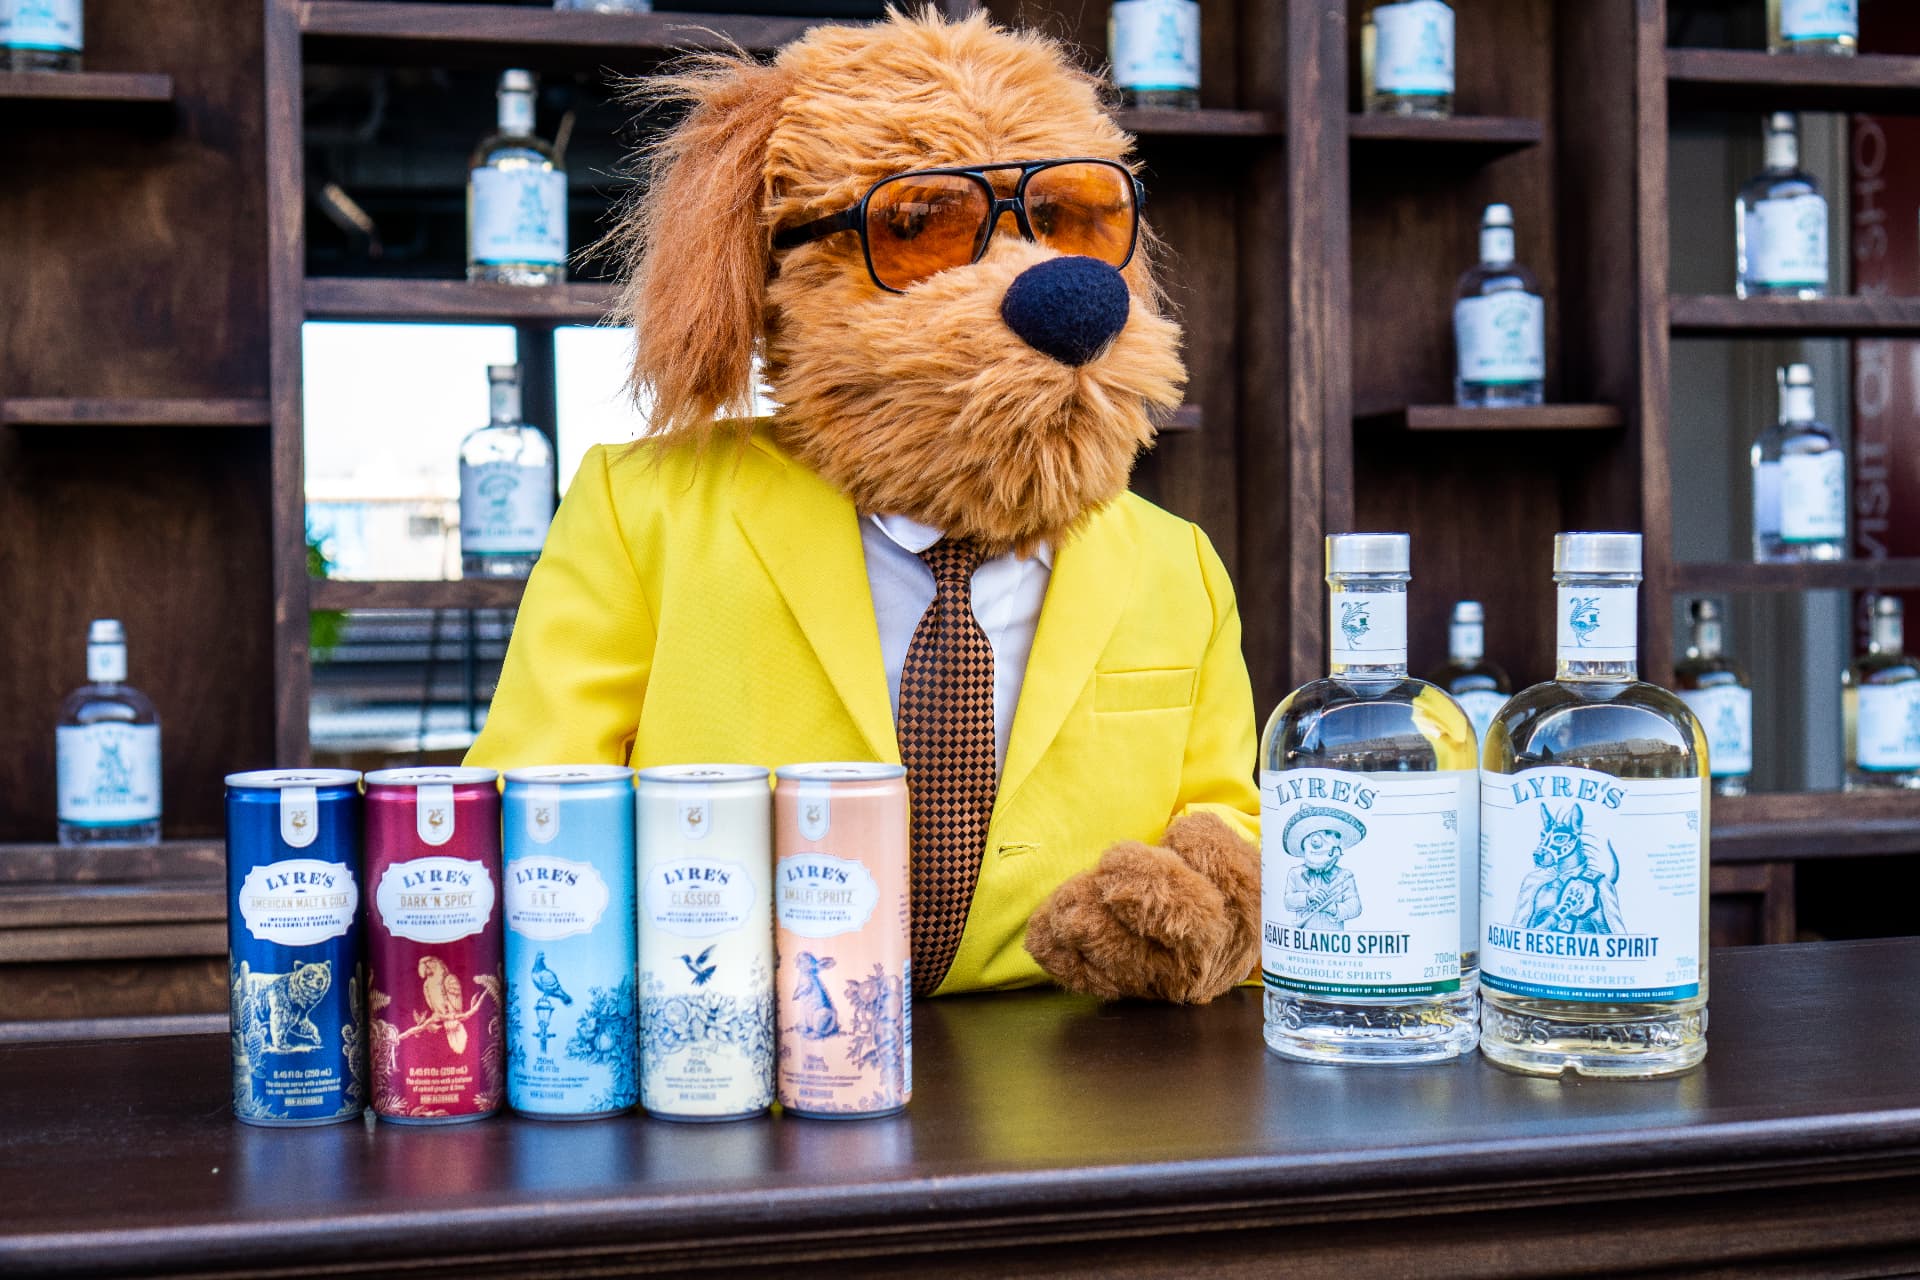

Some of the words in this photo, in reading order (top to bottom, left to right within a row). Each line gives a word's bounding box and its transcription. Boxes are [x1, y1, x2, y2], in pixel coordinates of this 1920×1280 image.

[1276, 777, 1377, 810] LYRE'S
[1512, 776, 1626, 809] LYRE'S
[265, 871, 335, 891] LYRE'S
[402, 870, 472, 889] LYRE'S
[516, 867, 581, 886] LYRE'S
[664, 867, 731, 885] LYRE'S
[787, 865, 849, 884] LYRE'S
[251, 898, 293, 910] AMERICAN
[296, 897, 318, 908] MALT
[401, 895, 428, 908] DARK
[444, 893, 472, 906] SPICY
[671, 892, 721, 905] CLASSICO
[817, 889, 853, 904] SPRITZ
[1264, 923, 1290, 947] AGAVE
[1294, 930, 1350, 954] BLANCO
[1357, 934, 1411, 954] SPIRIT
[1488, 925, 1521, 950] AGAVE
[1526, 932, 1600, 958] RESERVA
[1606, 937, 1659, 958] SPIRIT
[1271, 961, 1343, 979] NON-ALCOHOLIC
[1346, 970, 1392, 980] SPIRITS
[1588, 975, 1635, 985] SPIRITS
